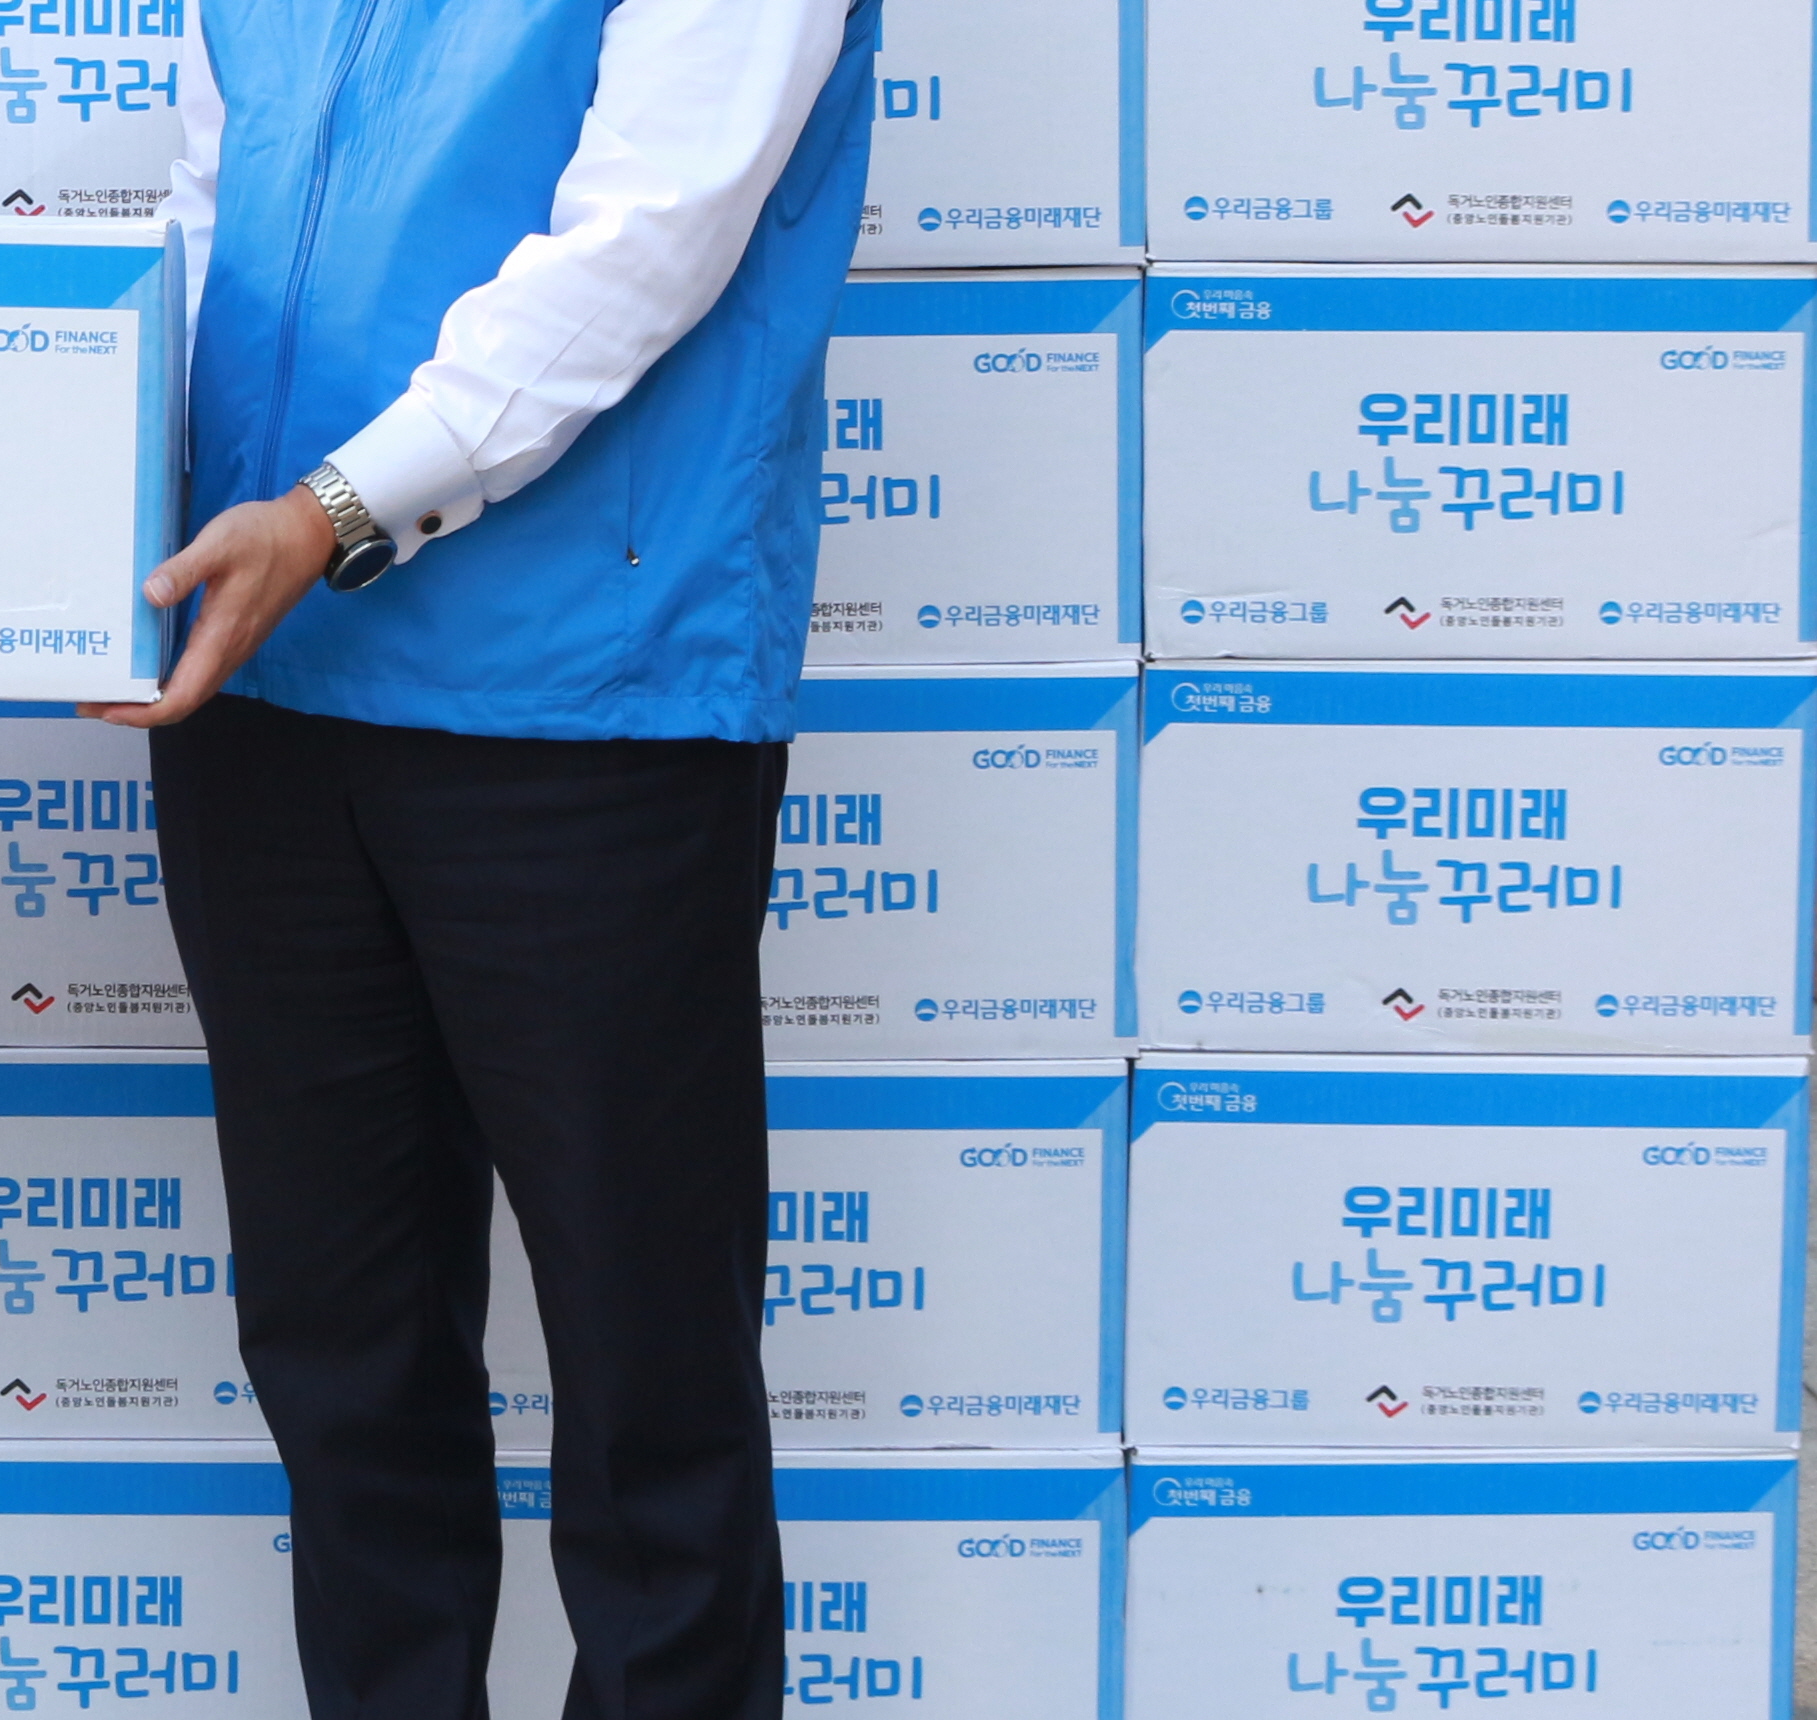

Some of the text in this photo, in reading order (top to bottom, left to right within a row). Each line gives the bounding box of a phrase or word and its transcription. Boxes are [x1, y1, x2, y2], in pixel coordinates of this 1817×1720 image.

[946, 207, 1101, 230] 우리금융미래재단
[1213, 197, 1333, 220] 우리금융그룹
[1635, 200, 1792, 223] 우리금융미래재단
[55, 331, 118, 343] FINANCE
[88, 346, 117, 355] NEXT
[974, 348, 1100, 374] GOOD FINANCE
[1359, 393, 1568, 446] 우리미래
[945, 604, 1101, 627] 우리금융미래재단
[1209, 601, 1328, 624] 우리금융그룹
[1626, 601, 1781, 623] 우리금융미래재단
[973, 745, 1041, 769] GOOD
[1358, 787, 1566, 841] 우리미래
[68, 983, 190, 998] 독거노인종합지원센터
[942, 998, 1097, 1020] 우리금융미래재단
[1206, 992, 1326, 1014] 우리금융그룹
[1623, 994, 1777, 1017] 우리금융미래재단
[1343, 1186, 1551, 1240] 우리미래
[57, 1377, 178, 1393] 독거노인종합지원센터
[927, 1395, 1081, 1416] 우리금융미래재단
[1191, 1388, 1310, 1411] 우리금융그룹
[1605, 1392, 1758, 1414] 우리금융미래재단
[1337, 1575, 1542, 1628] 우리미래
